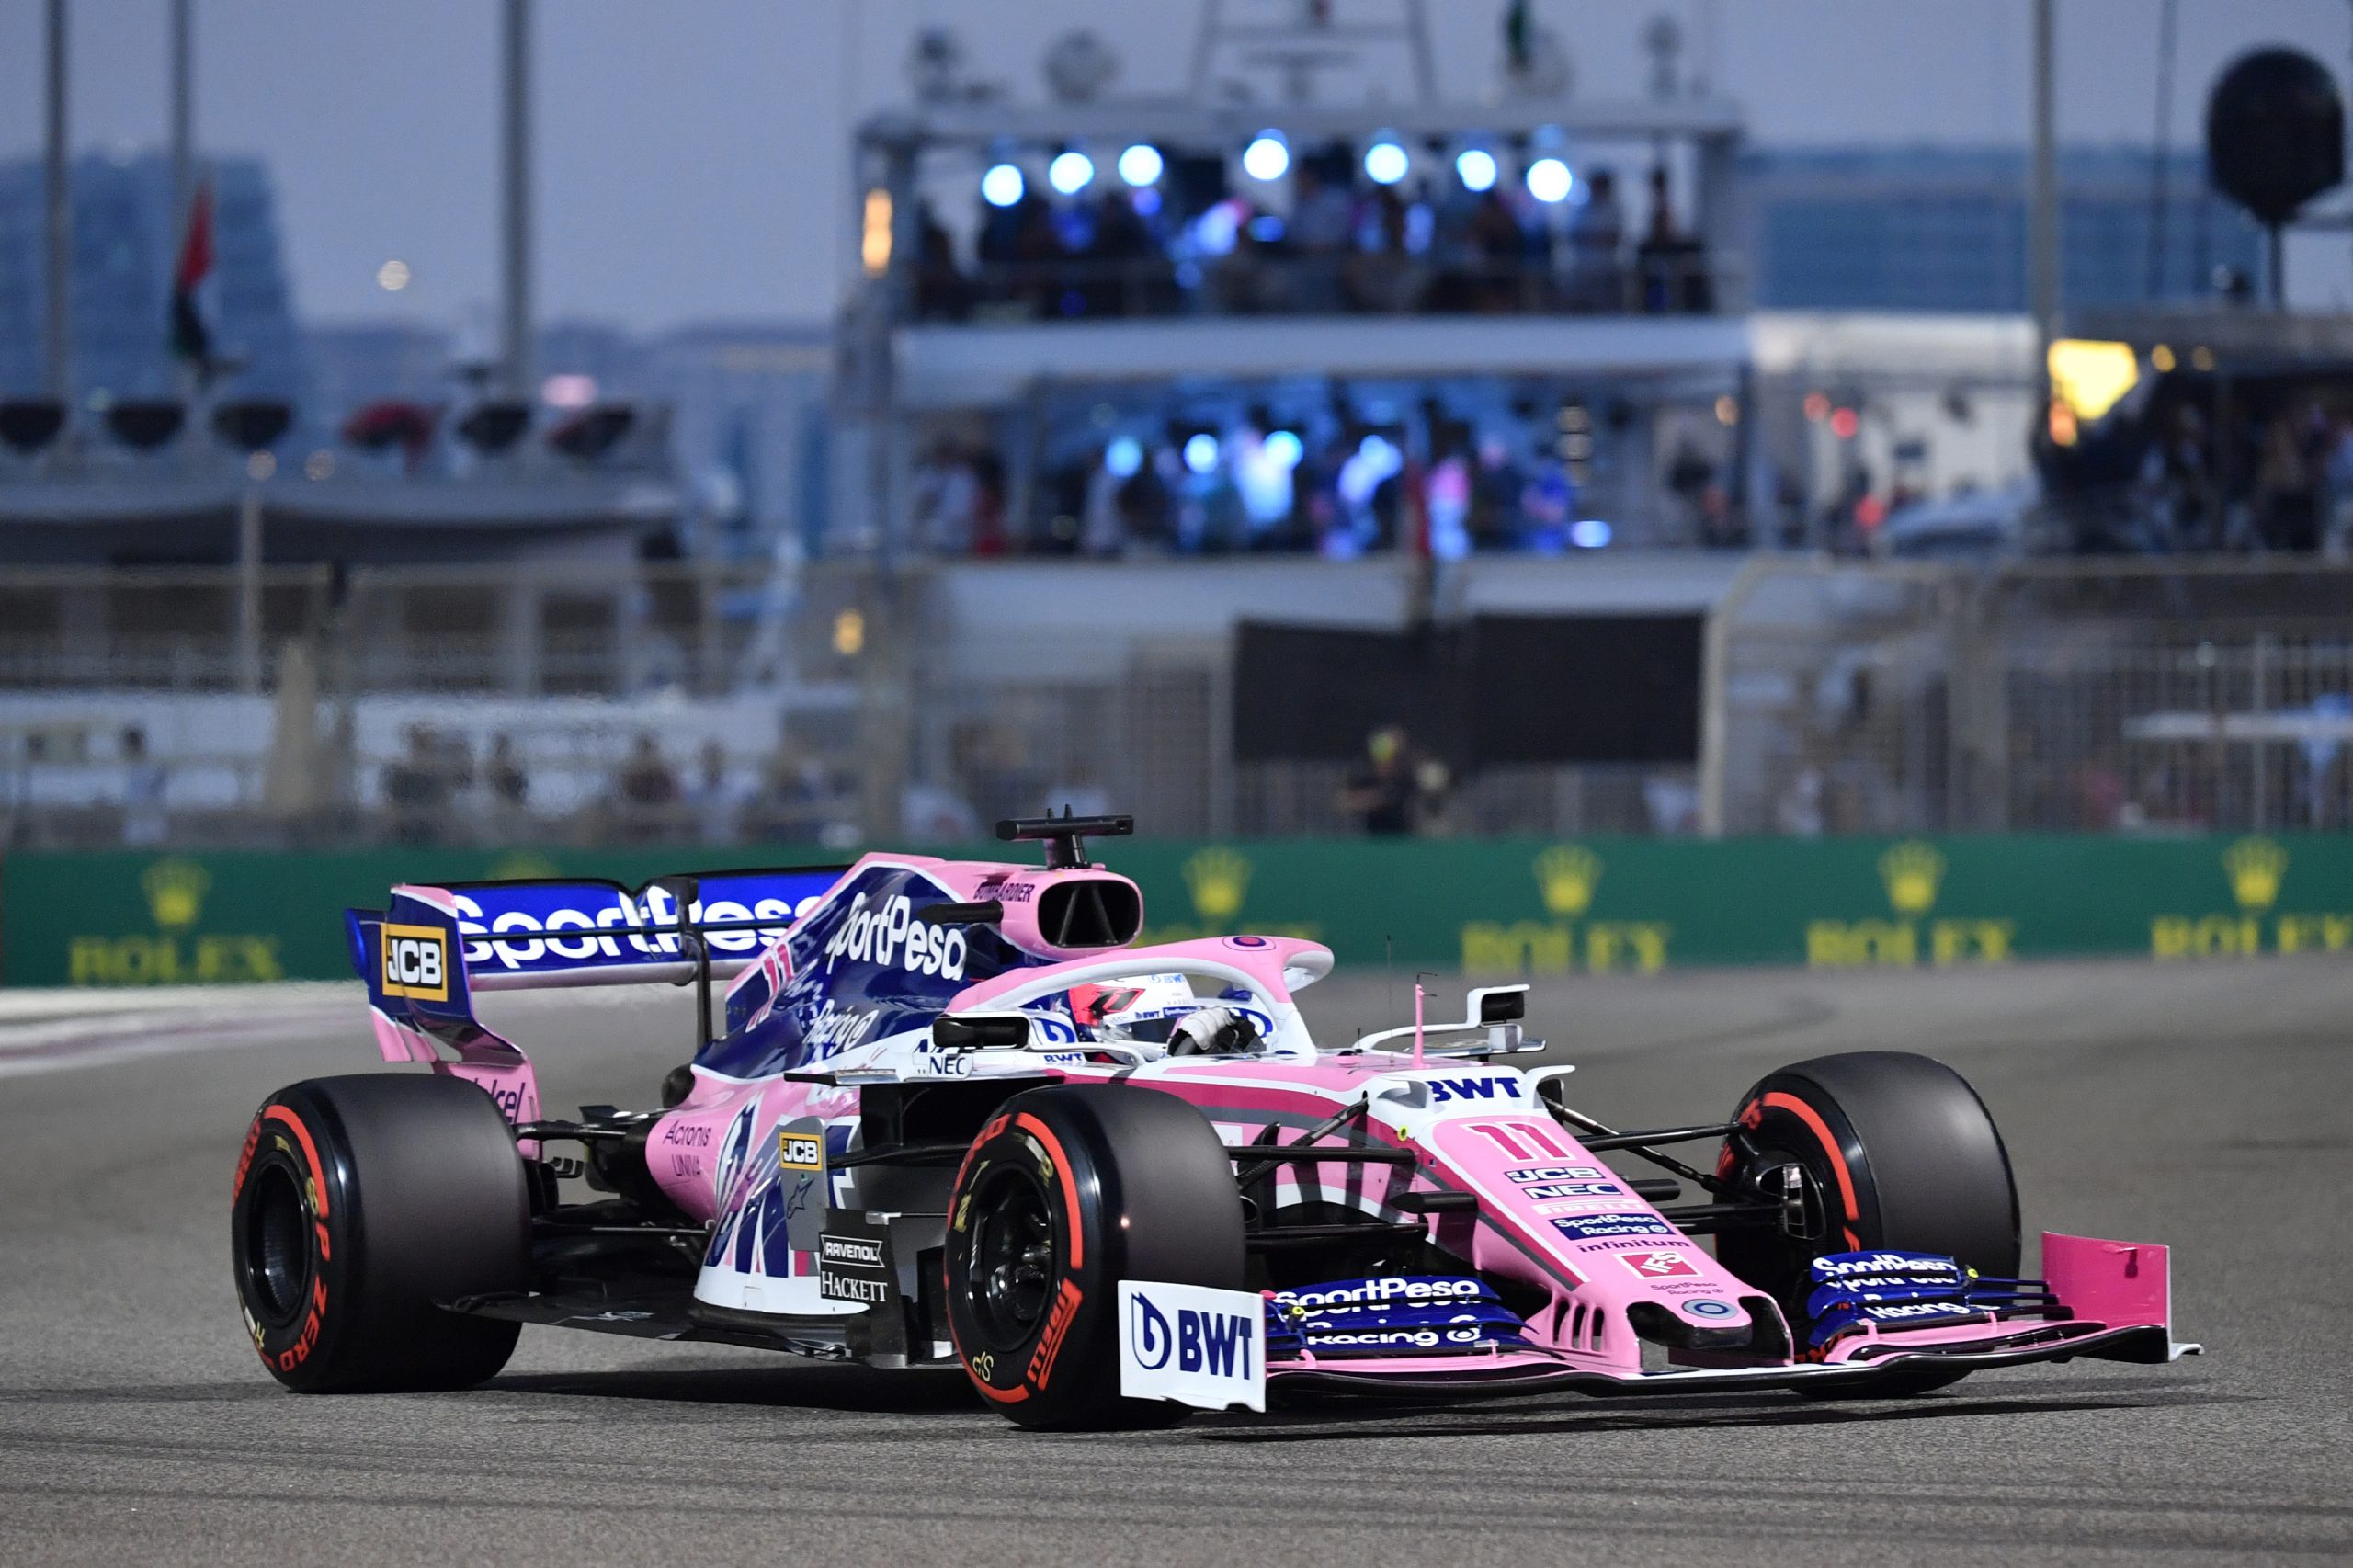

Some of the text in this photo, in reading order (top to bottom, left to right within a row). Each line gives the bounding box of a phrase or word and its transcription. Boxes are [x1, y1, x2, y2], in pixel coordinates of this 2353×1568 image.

[387, 937, 442, 986] JCB
[929, 1056, 965, 1075] NEC
[1426, 1077, 1522, 1102] BWT
[662, 1120, 711, 1147] Acronis
[1459, 1121, 1576, 1163] 11
[783, 1141, 818, 1164] JCB
[1506, 1167, 1604, 1183] JCB
[1524, 1184, 1622, 1199] NEC
[1530, 1199, 1646, 1215] PIRELLI
[1554, 1214, 1659, 1228] SportPesa
[1580, 1224, 1649, 1235] Racing
[825, 1241, 879, 1262] RAVENOL
[1577, 1239, 1690, 1253] infinitum
[1640, 1252, 1686, 1275] IFS
[821, 1271, 888, 1301] HACKETT
[1651, 1282, 1717, 1290] SportPesa
[279, 1274, 328, 1372] ZERO
[1178, 1309, 1253, 1380] BWT
